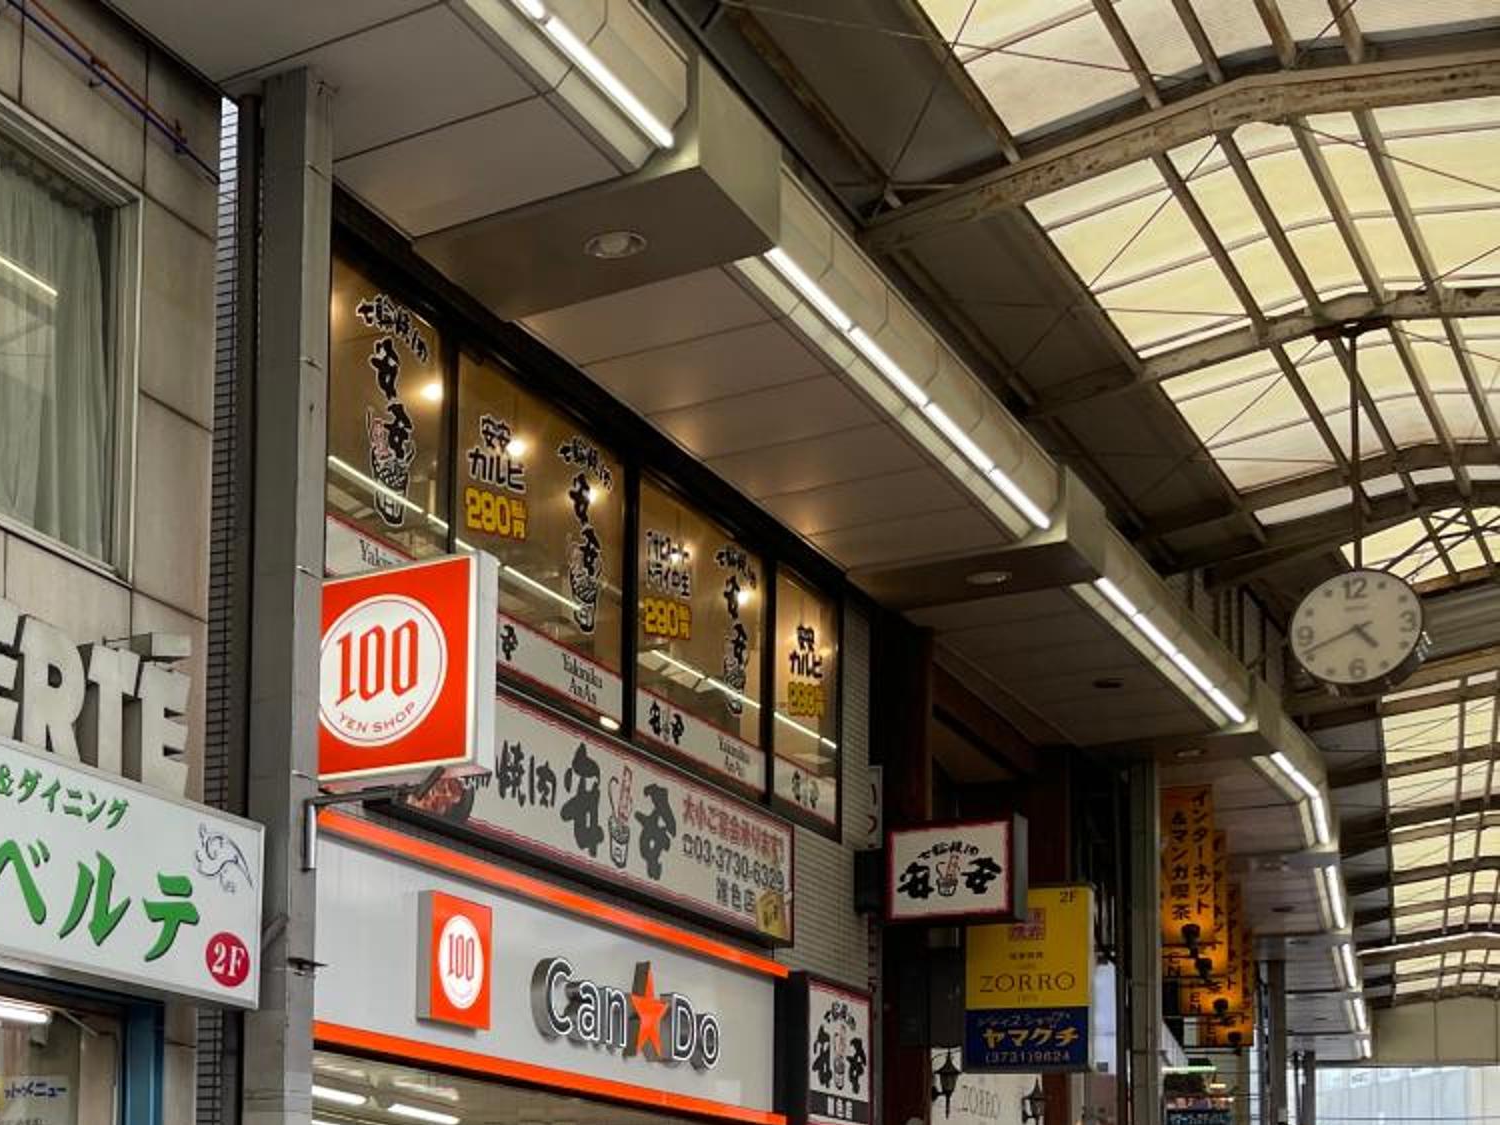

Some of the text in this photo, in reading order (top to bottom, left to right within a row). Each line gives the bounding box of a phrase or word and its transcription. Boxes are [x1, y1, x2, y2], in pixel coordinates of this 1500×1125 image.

[468, 447, 527, 493] カルビ
[1343, 577, 1368, 599] 12
[1297, 625, 1314, 647] 9
[1399, 610, 1415, 632] 3
[336, 619, 419, 706] 100
[1348, 658, 1367, 679] 6
[340, 701, 416, 733] YEN SHOP
[211, 940, 246, 980] 2F
[447, 932, 476, 982] 100
[979, 971, 1076, 993] ZORRO
[547, 957, 720, 1070] Can Do
